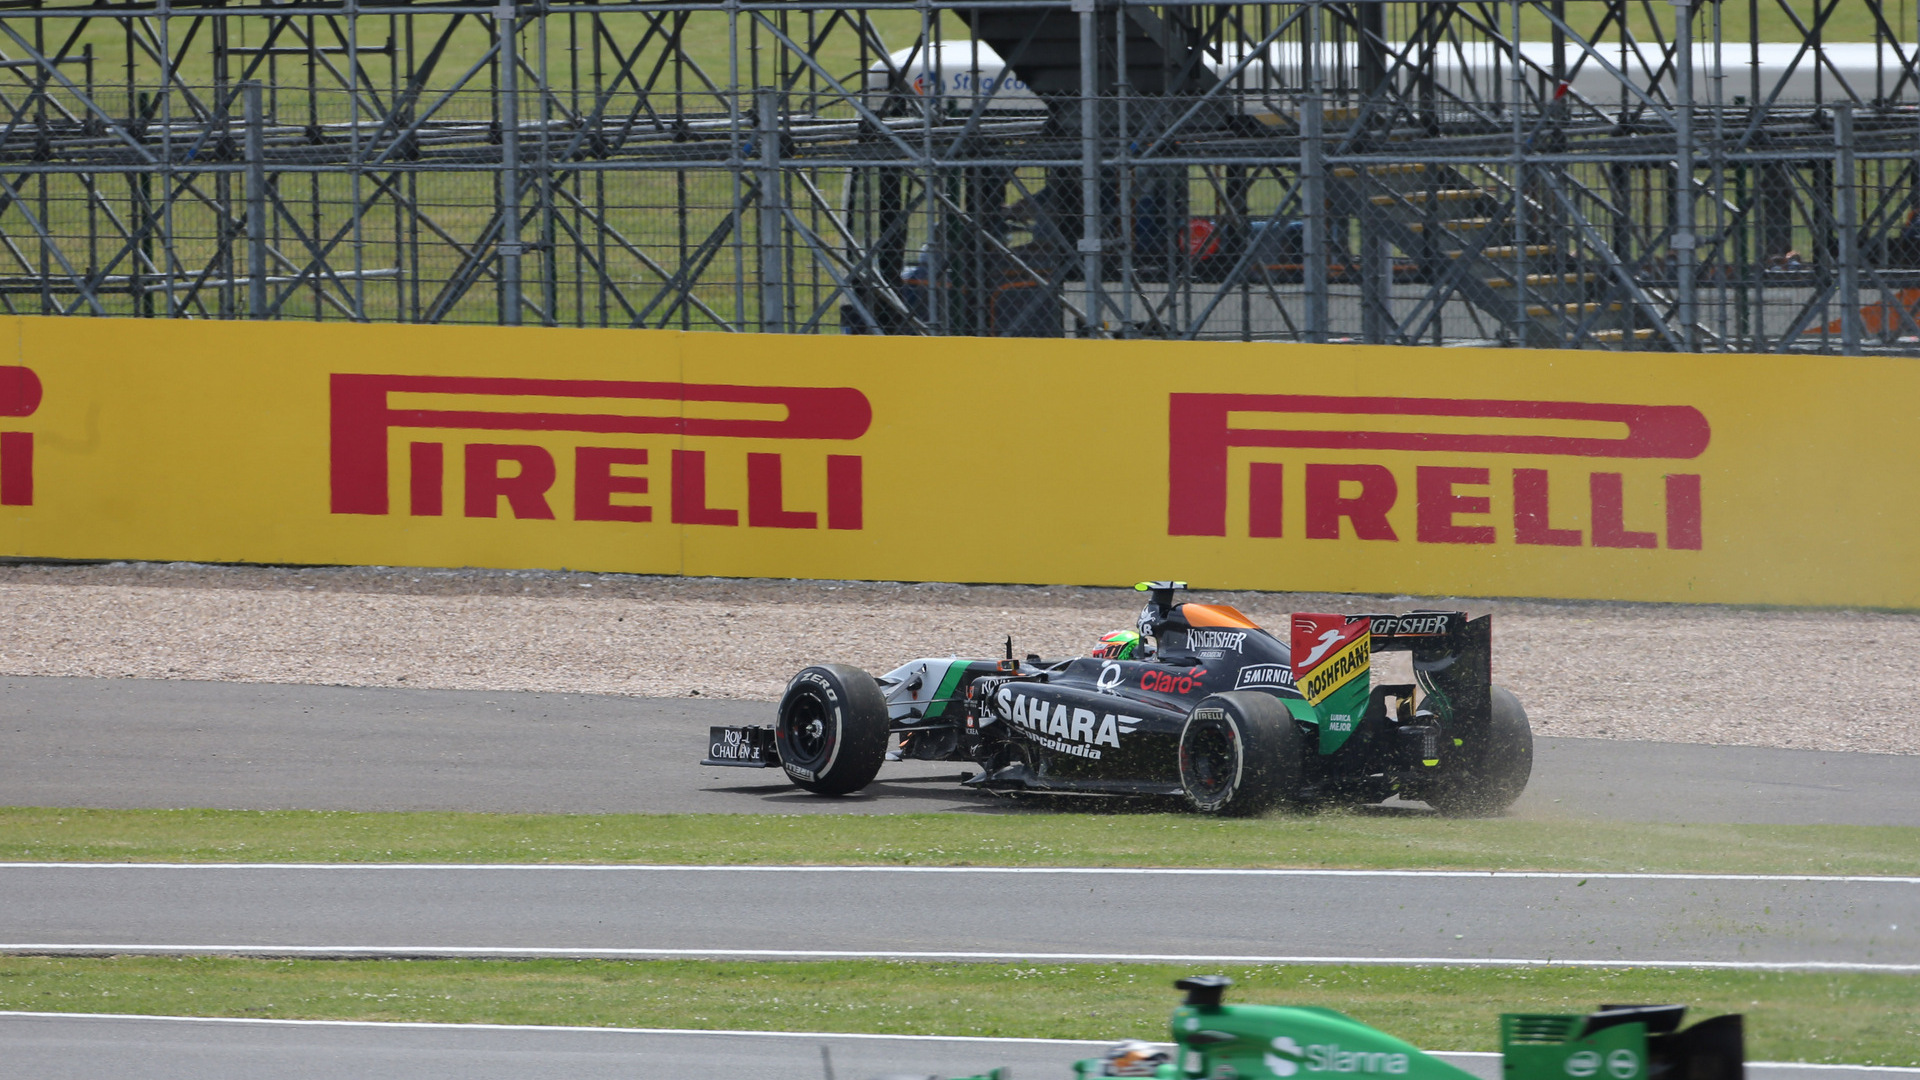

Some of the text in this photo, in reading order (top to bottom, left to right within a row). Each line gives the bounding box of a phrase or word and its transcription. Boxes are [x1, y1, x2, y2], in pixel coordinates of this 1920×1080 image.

[330, 373, 872, 530] PIRELLI
[1168, 392, 1711, 550] PIRELLI
[1345, 615, 1449, 635] GFISHER
[1186, 628, 1247, 655] KINGFISHER
[1140, 668, 1194, 694] Claro
[1243, 669, 1297, 687] SMIRNOF
[1307, 640, 1370, 701] ROSHFRANS
[800, 672, 838, 701] ZERO
[997, 688, 1120, 749] SAHARA
[1194, 707, 1225, 720] PIRELLI
[724, 729, 750, 747] ROYL
[1328, 722, 1352, 732] MEJOR
